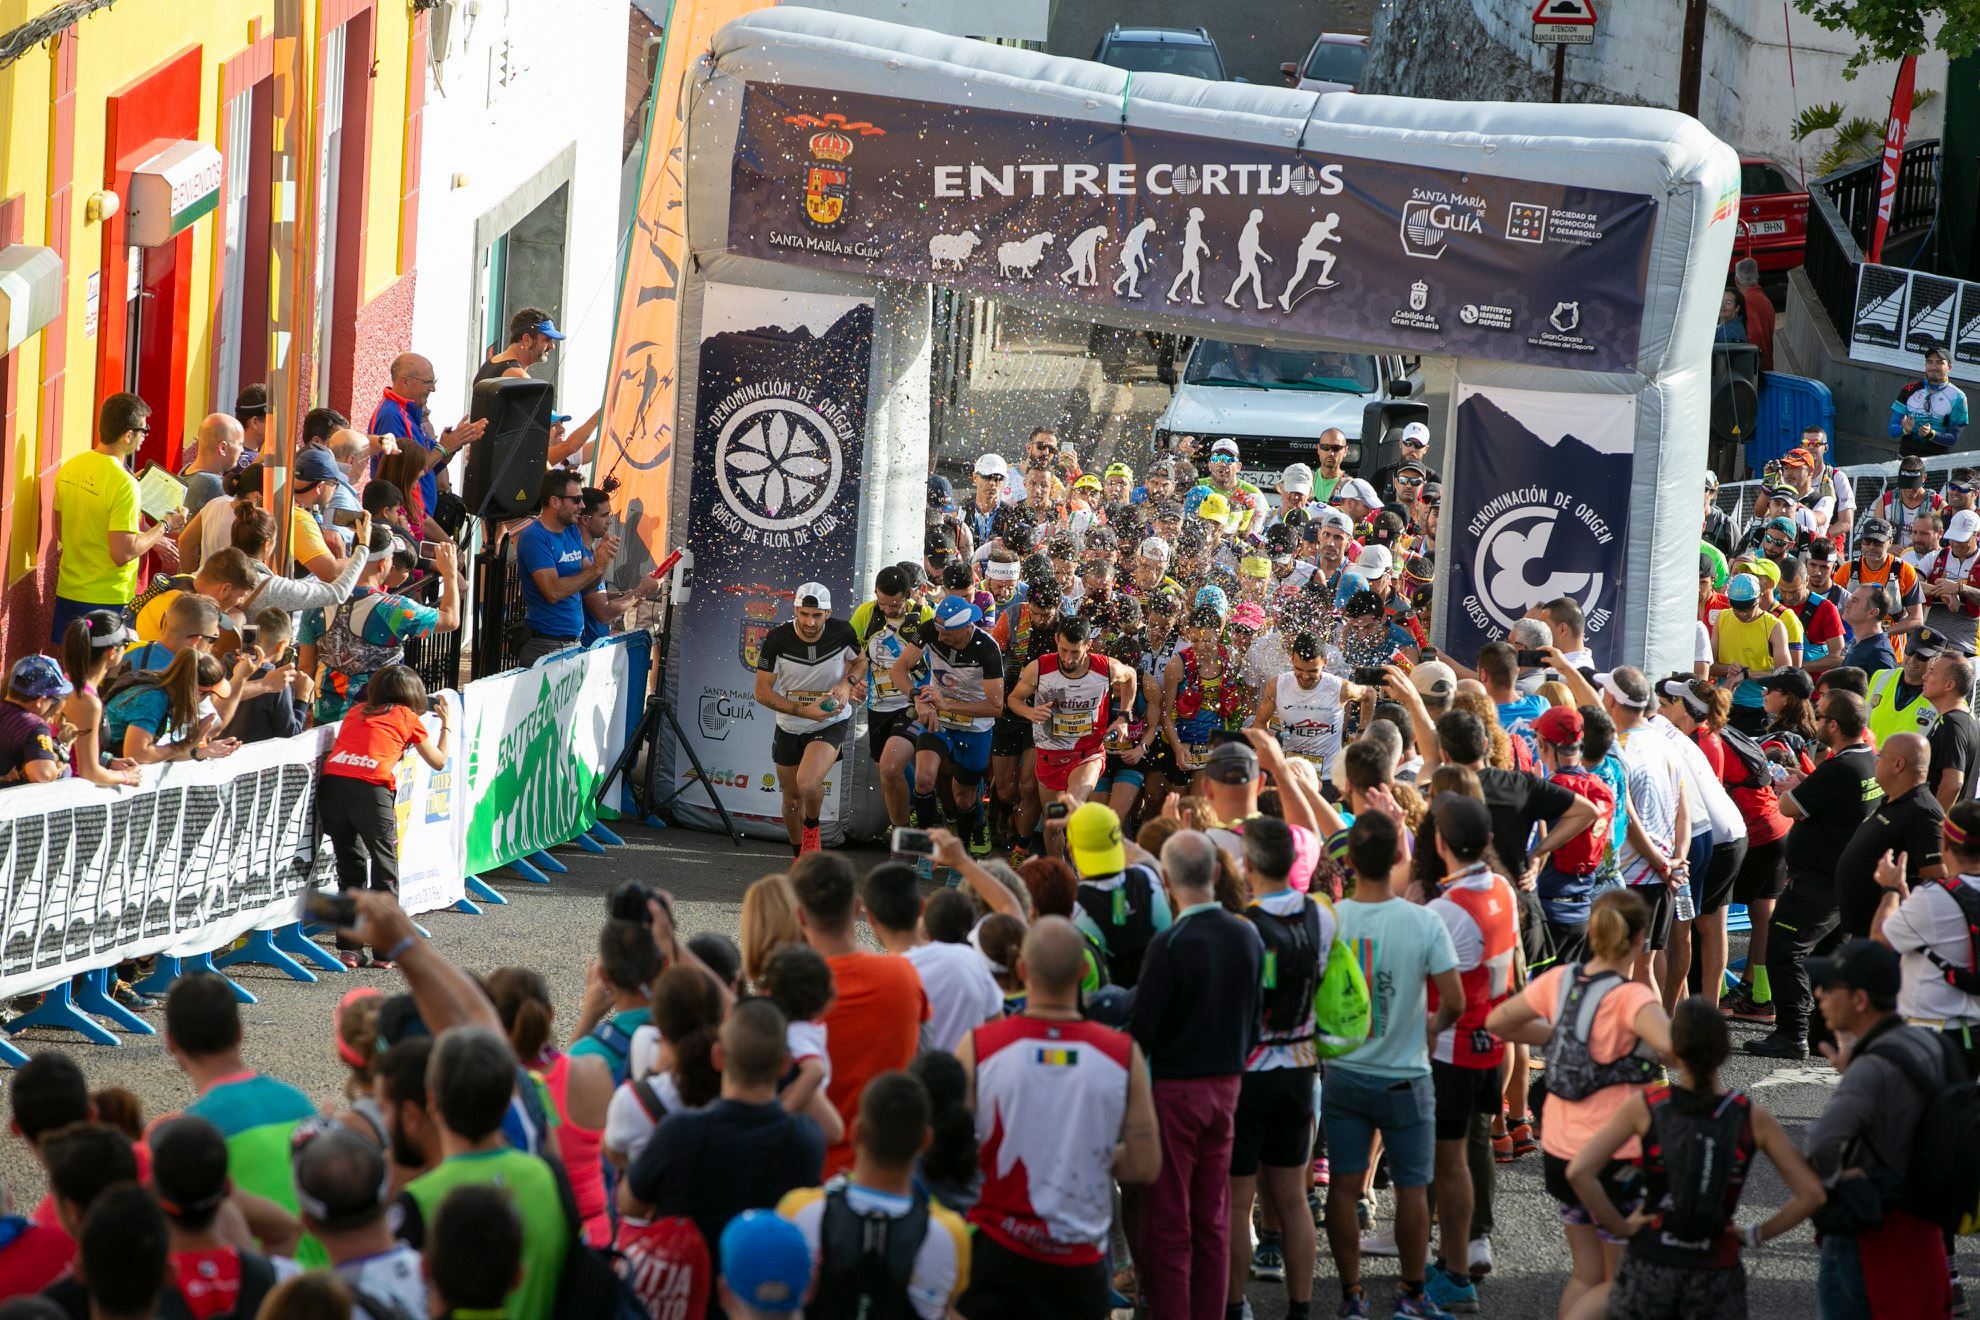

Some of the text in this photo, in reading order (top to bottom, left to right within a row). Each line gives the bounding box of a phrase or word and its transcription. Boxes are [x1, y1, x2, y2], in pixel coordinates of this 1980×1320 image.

[1557, 34, 1592, 42] REDUCTORAS
[173, 161, 221, 211] BIENVENIDOS
[1412, 187, 1487, 208] SANTA MARÍA
[1429, 203, 1483, 234] GUÍA
[1475, 208, 1486, 217] DE
[1551, 209, 1586, 220] SOCIEDAD
[1550, 218, 1595, 230] PROMOCIÓN
[1764, 221, 1783, 232] BHN
[1556, 228, 1602, 239] DESARROLLO
[769, 230, 879, 258] SANTA MARÍA DE GUÍA
[1395, 309, 1424, 320] Cabildo
[1480, 304, 1512, 315] INSTITUTO
[1858, 296, 1883, 319] arista
[1909, 305, 1932, 327] arista
[1391, 317, 1440, 330] Gran Canaria
[1478, 319, 1511, 329] DEPORTES
[709, 379, 855, 440] DENOMINACIÓN DE ORIGEN
[1468, 484, 1614, 545] DENOMINACIÓN DE ORIGEN
[712, 502, 840, 548] QUESO DE FLOR DE GUÍA
[1462, 595, 1612, 642] QUESO DE GUÍA
[703, 686, 755, 701] SANTA MARÍA
[716, 698, 755, 720] GUÍA
